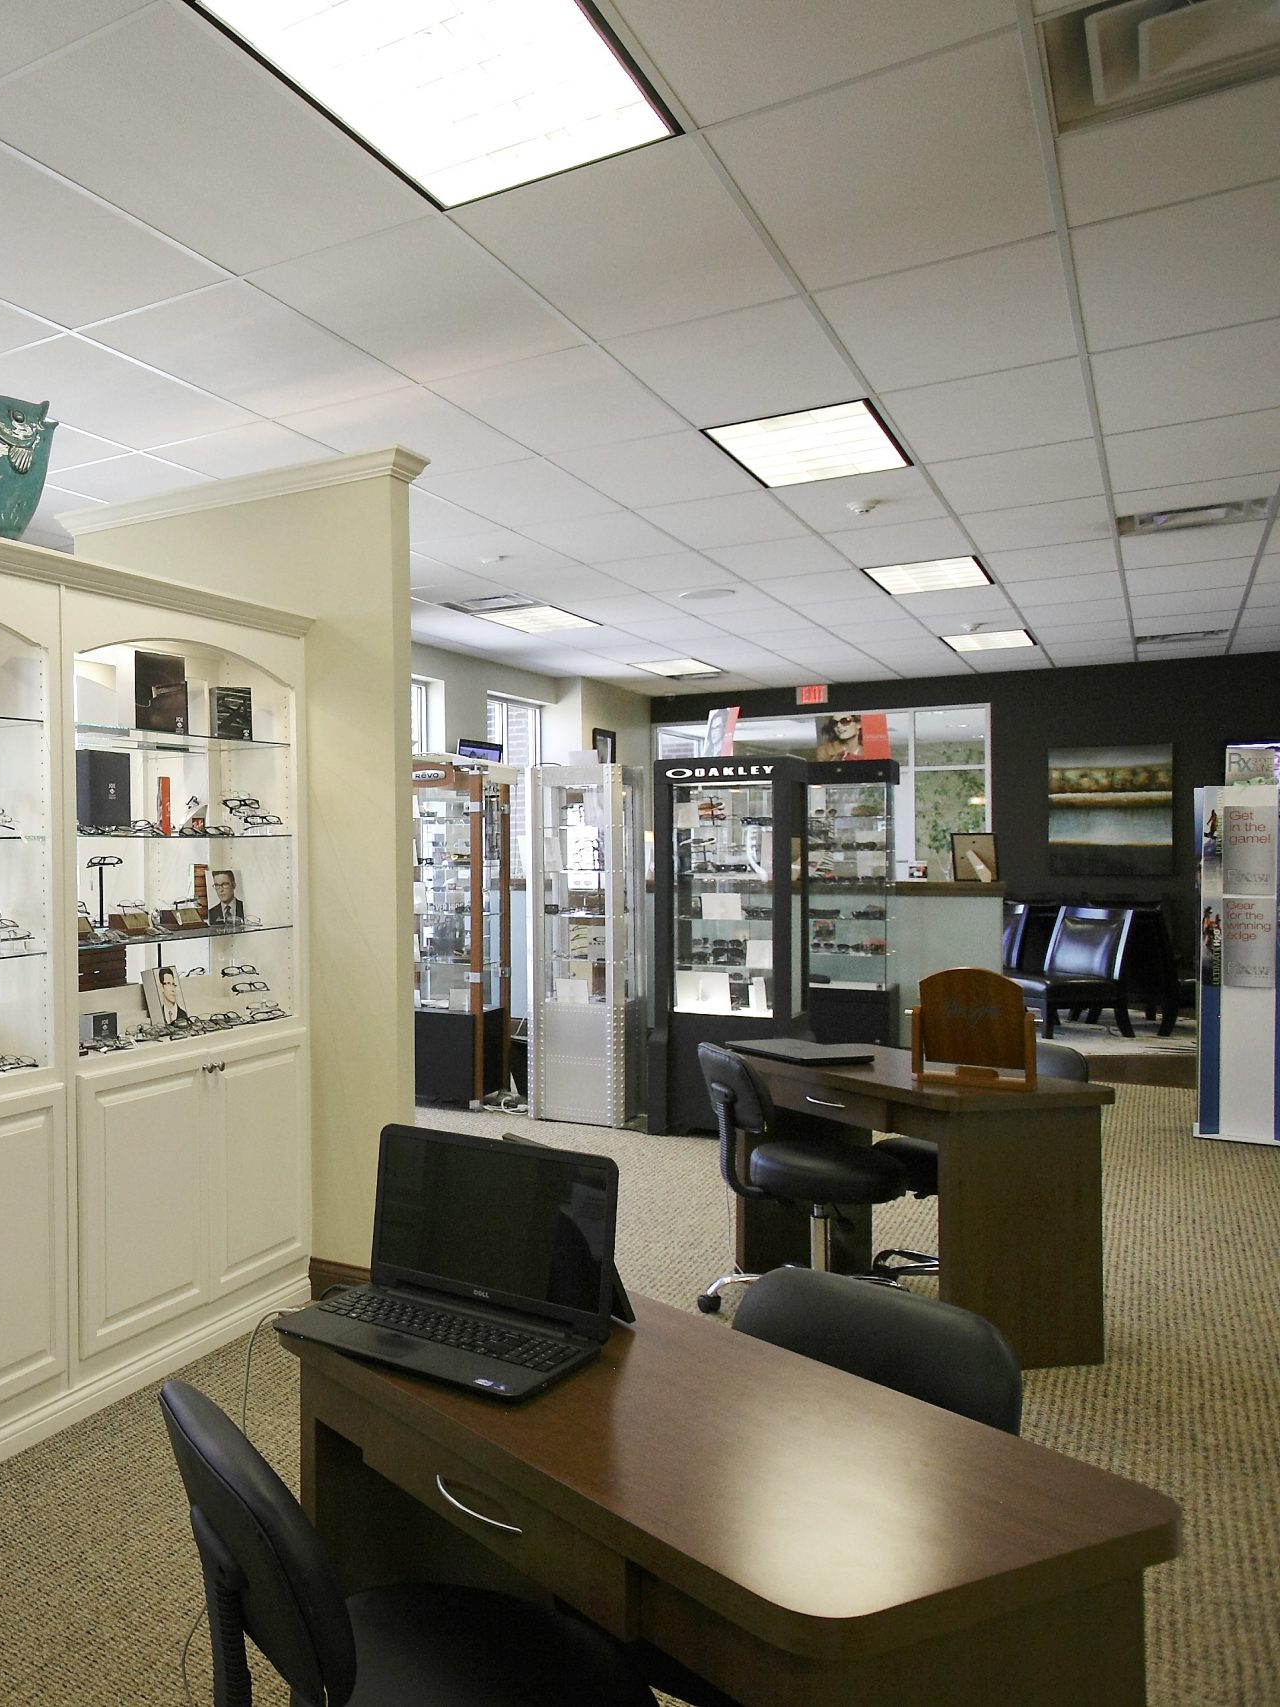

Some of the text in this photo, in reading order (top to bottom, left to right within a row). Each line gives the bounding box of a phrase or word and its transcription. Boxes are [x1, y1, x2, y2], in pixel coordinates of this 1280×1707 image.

[694, 765, 774, 777] OAKLEY
[1229, 810, 1254, 821] Get
[1229, 822, 1266, 832] in the
[1230, 834, 1271, 846] game!
[1227, 901, 1255, 910] Gear
[1227, 911, 1264, 920] for the
[1227, 922, 1272, 933] winning
[1227, 931, 1257, 942] edge
[473, 1289, 490, 1299] DELL
